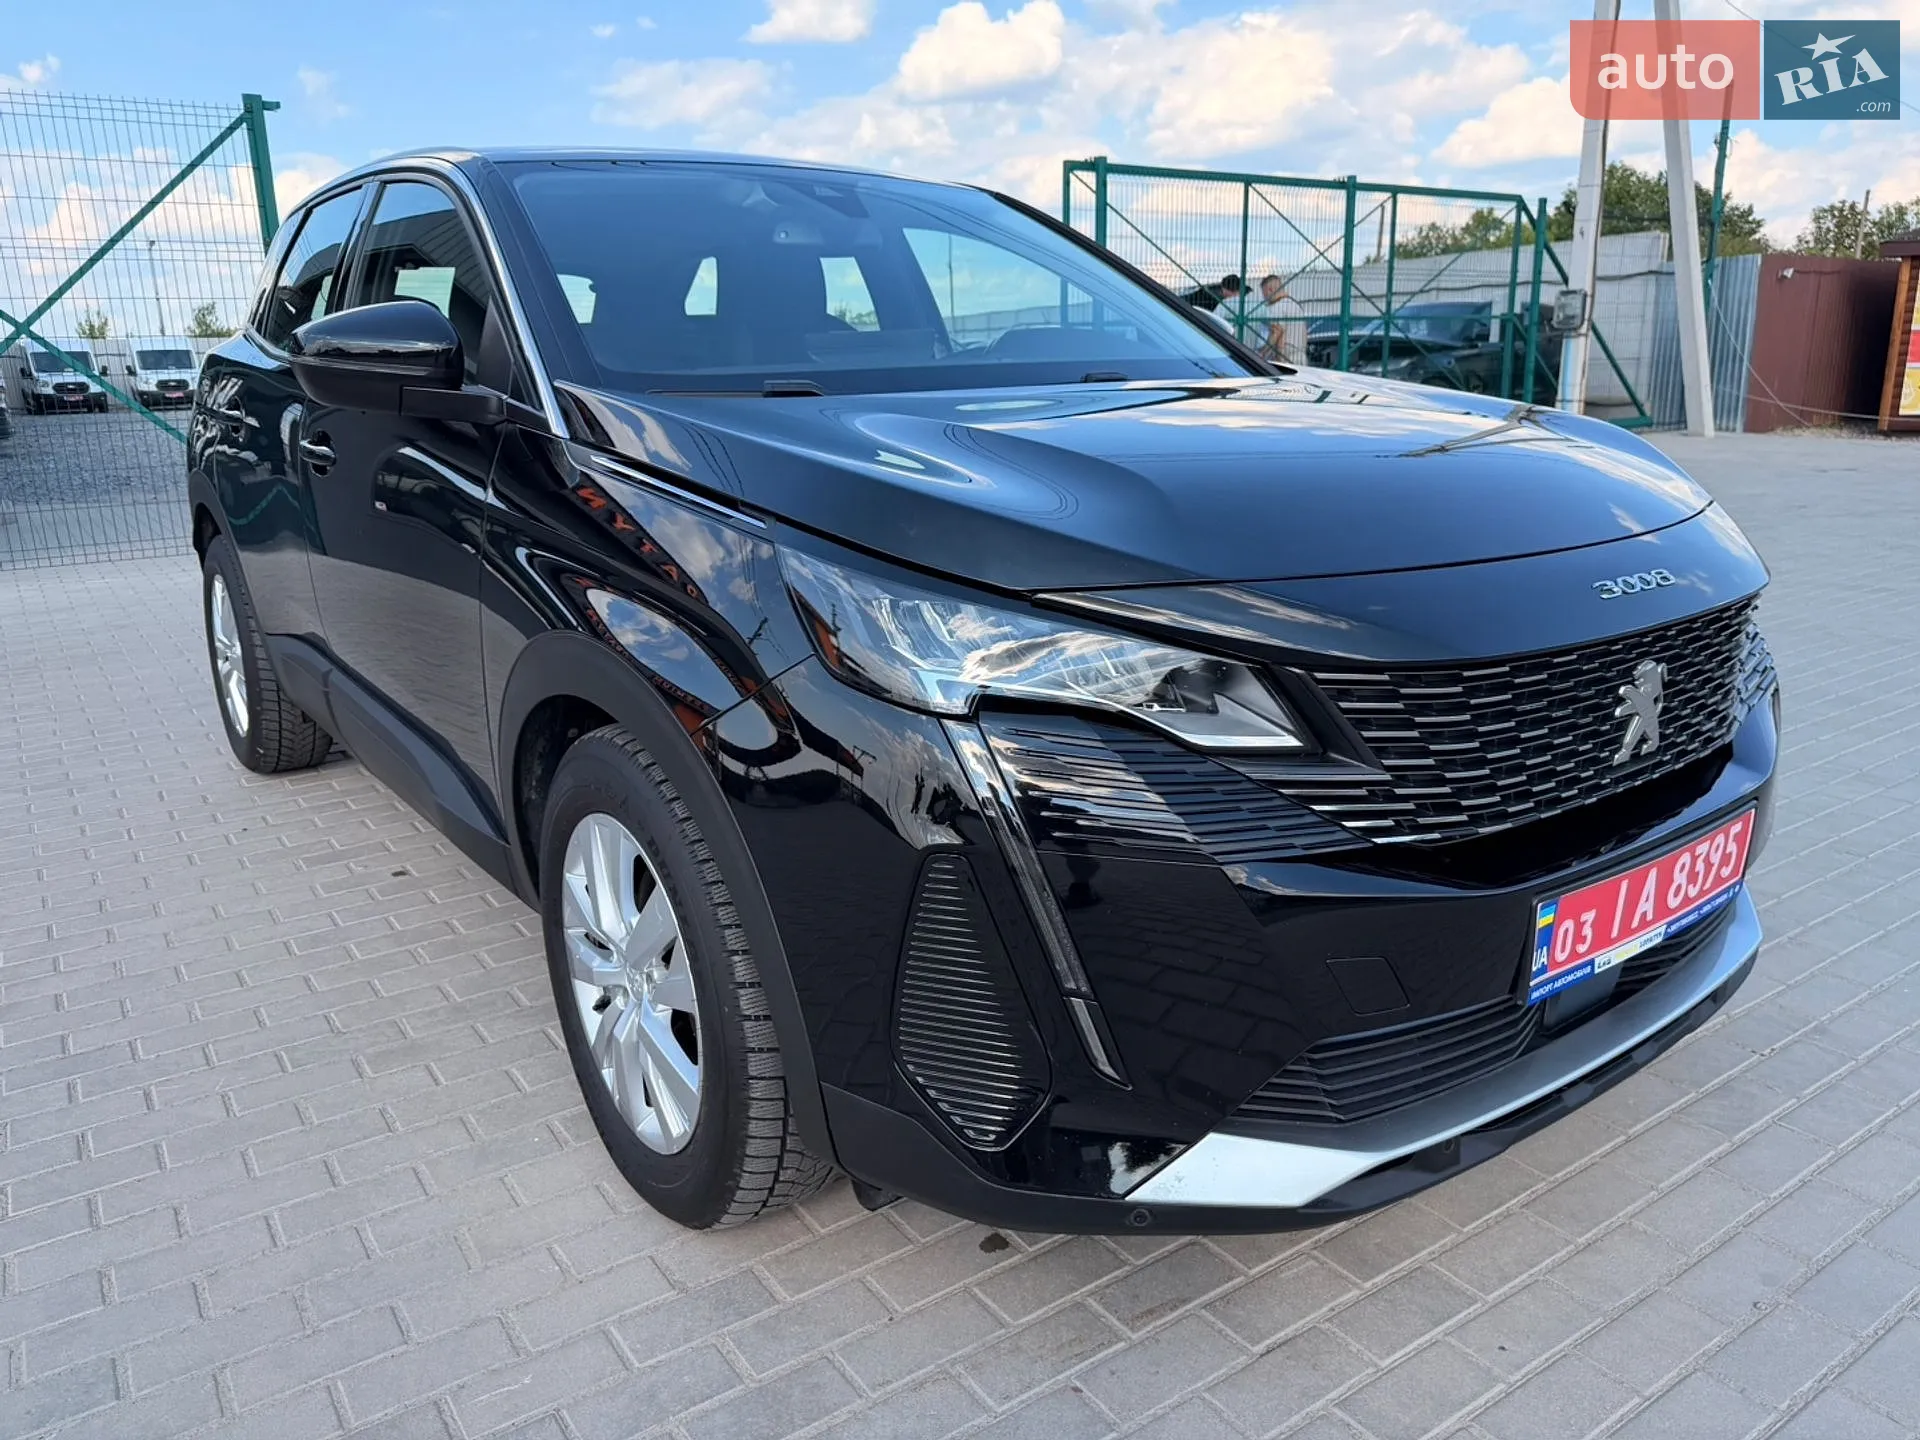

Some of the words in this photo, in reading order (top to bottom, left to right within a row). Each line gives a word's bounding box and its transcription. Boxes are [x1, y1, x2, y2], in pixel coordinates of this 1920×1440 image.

[1592, 569, 1676, 599] 3008
[1554, 908, 1597, 963] 03
[1610, 867, 1658, 939] IA
[1667, 821, 1744, 910] 8395
[1532, 945, 1548, 971] UA
